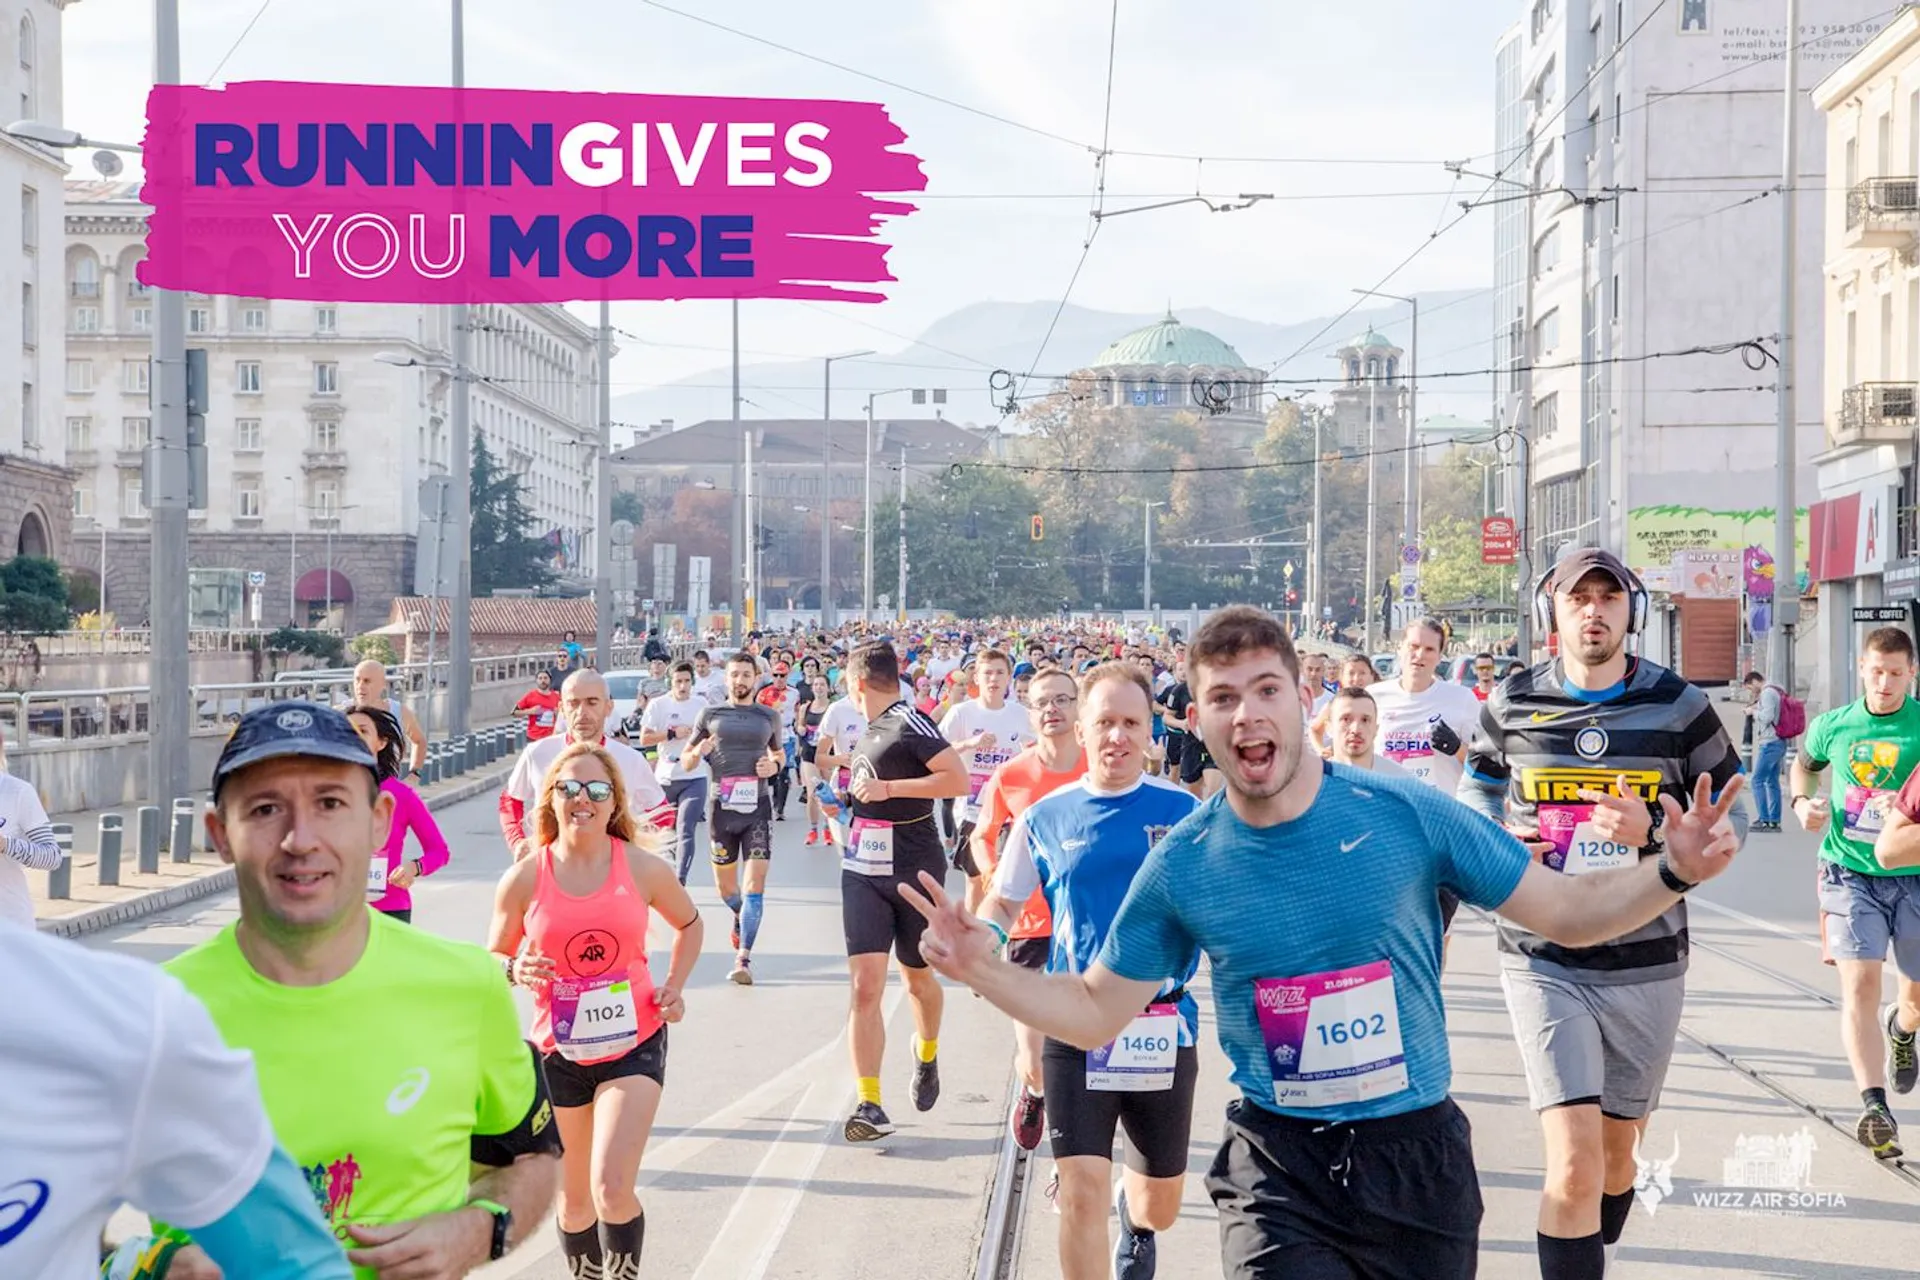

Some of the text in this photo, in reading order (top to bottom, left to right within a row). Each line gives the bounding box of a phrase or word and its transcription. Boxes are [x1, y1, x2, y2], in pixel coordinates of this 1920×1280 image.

[1879, 608, 1904, 619] COFFEE
[1385, 731, 1412, 739] WIZZ
[1385, 741, 1432, 751] SOFIA
[1578, 841, 1628, 857] 1206
[585, 1004, 625, 1022] 1102
[1316, 1013, 1387, 1046] 1602
[1122, 1037, 1169, 1052] 1460
